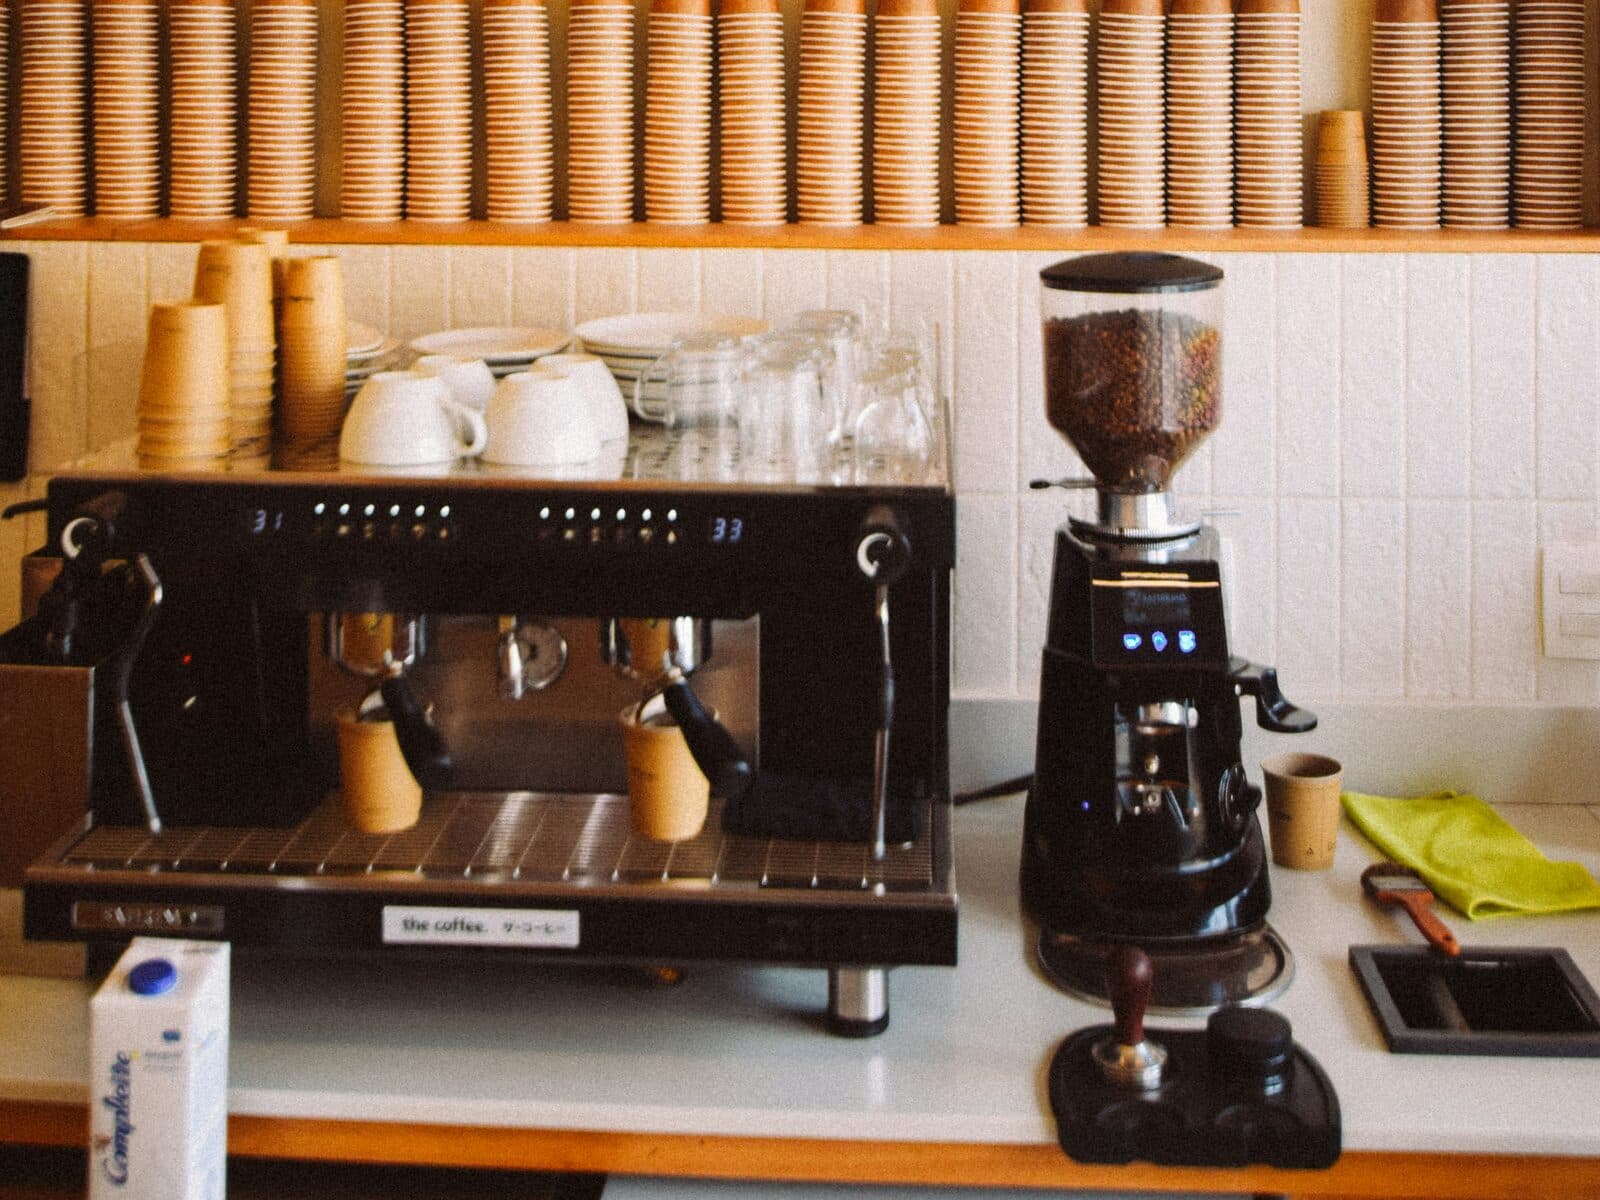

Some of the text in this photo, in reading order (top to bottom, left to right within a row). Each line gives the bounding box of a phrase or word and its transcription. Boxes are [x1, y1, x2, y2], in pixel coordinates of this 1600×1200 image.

[253, 509, 283, 533] 31
[713, 517, 743, 543] 33
[402, 917, 430, 933] the
[434, 916, 489, 934] coffee.
